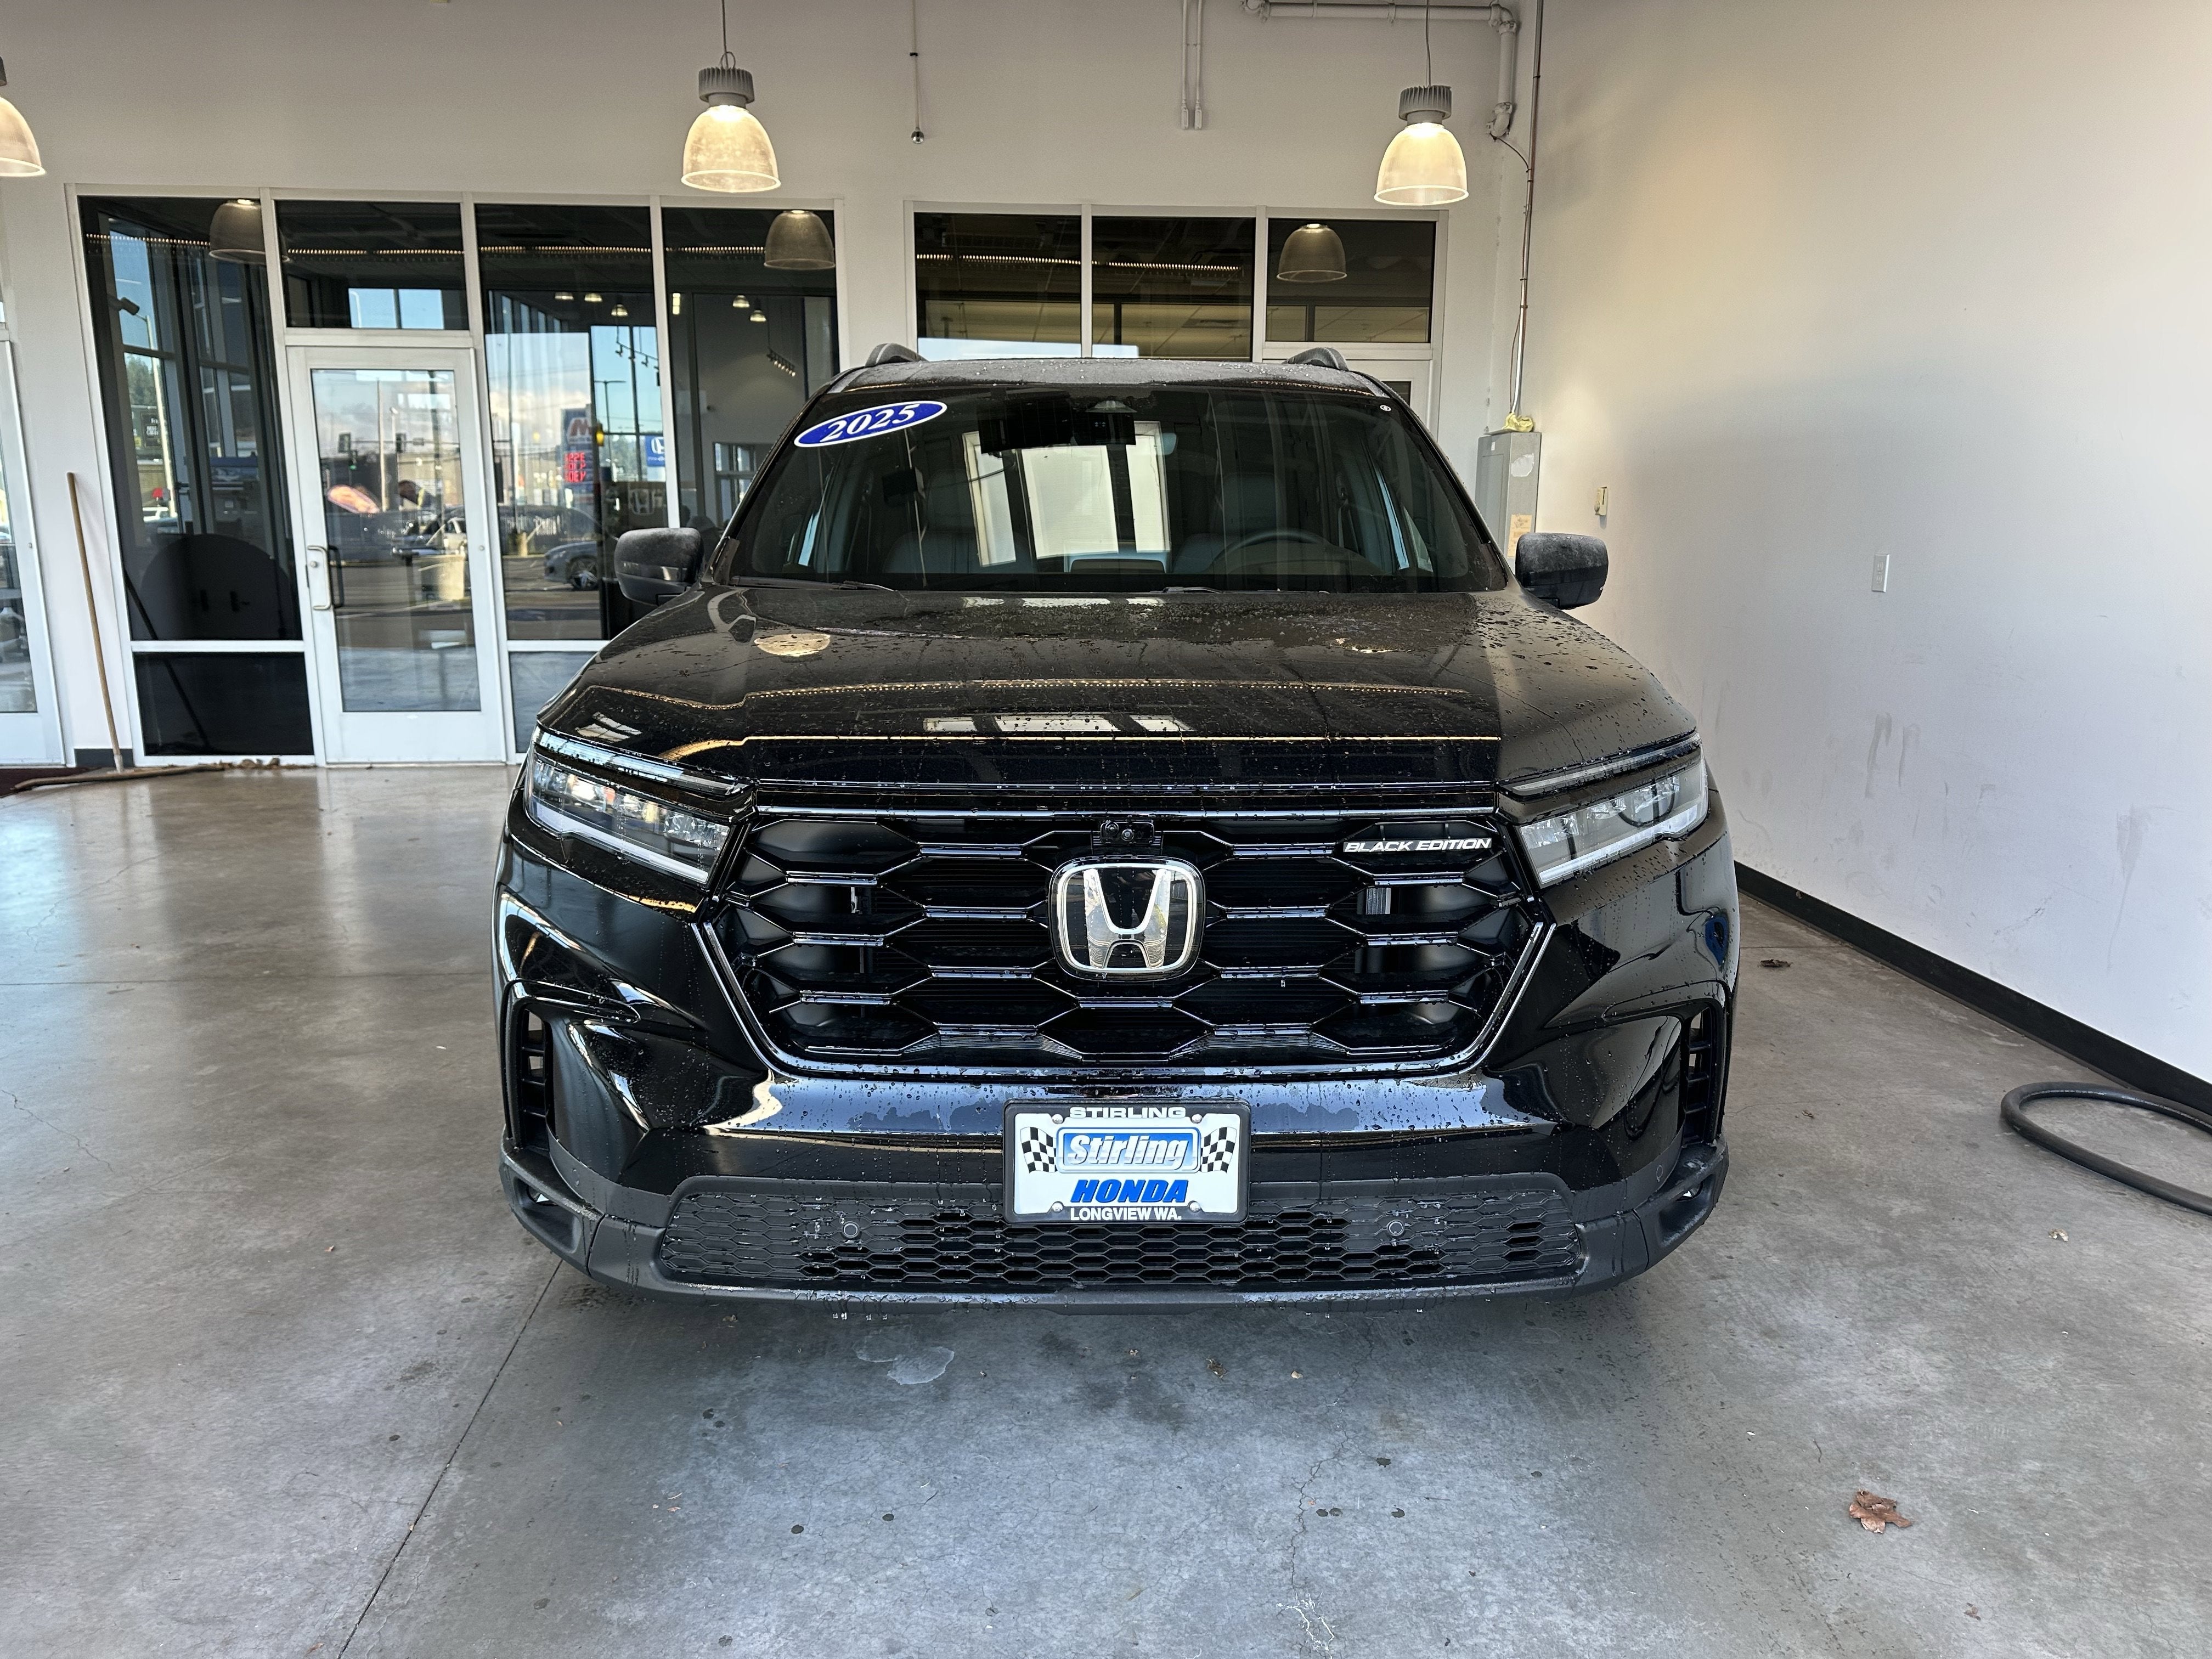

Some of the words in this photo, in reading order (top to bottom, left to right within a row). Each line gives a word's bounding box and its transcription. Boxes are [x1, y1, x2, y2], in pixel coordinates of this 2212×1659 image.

[820, 403, 921, 443] 2025
[1344, 840, 1414, 853] BLACK
[1415, 838, 1492, 851] EDITION
[1069, 1107, 1186, 1119] STIRLING
[1068, 1135, 1189, 1169] Stirling
[1070, 1179, 1189, 1203] HONDA
[1070, 1207, 1152, 1221] LONGVIEW
[1154, 1207, 1182, 1221] WA.
